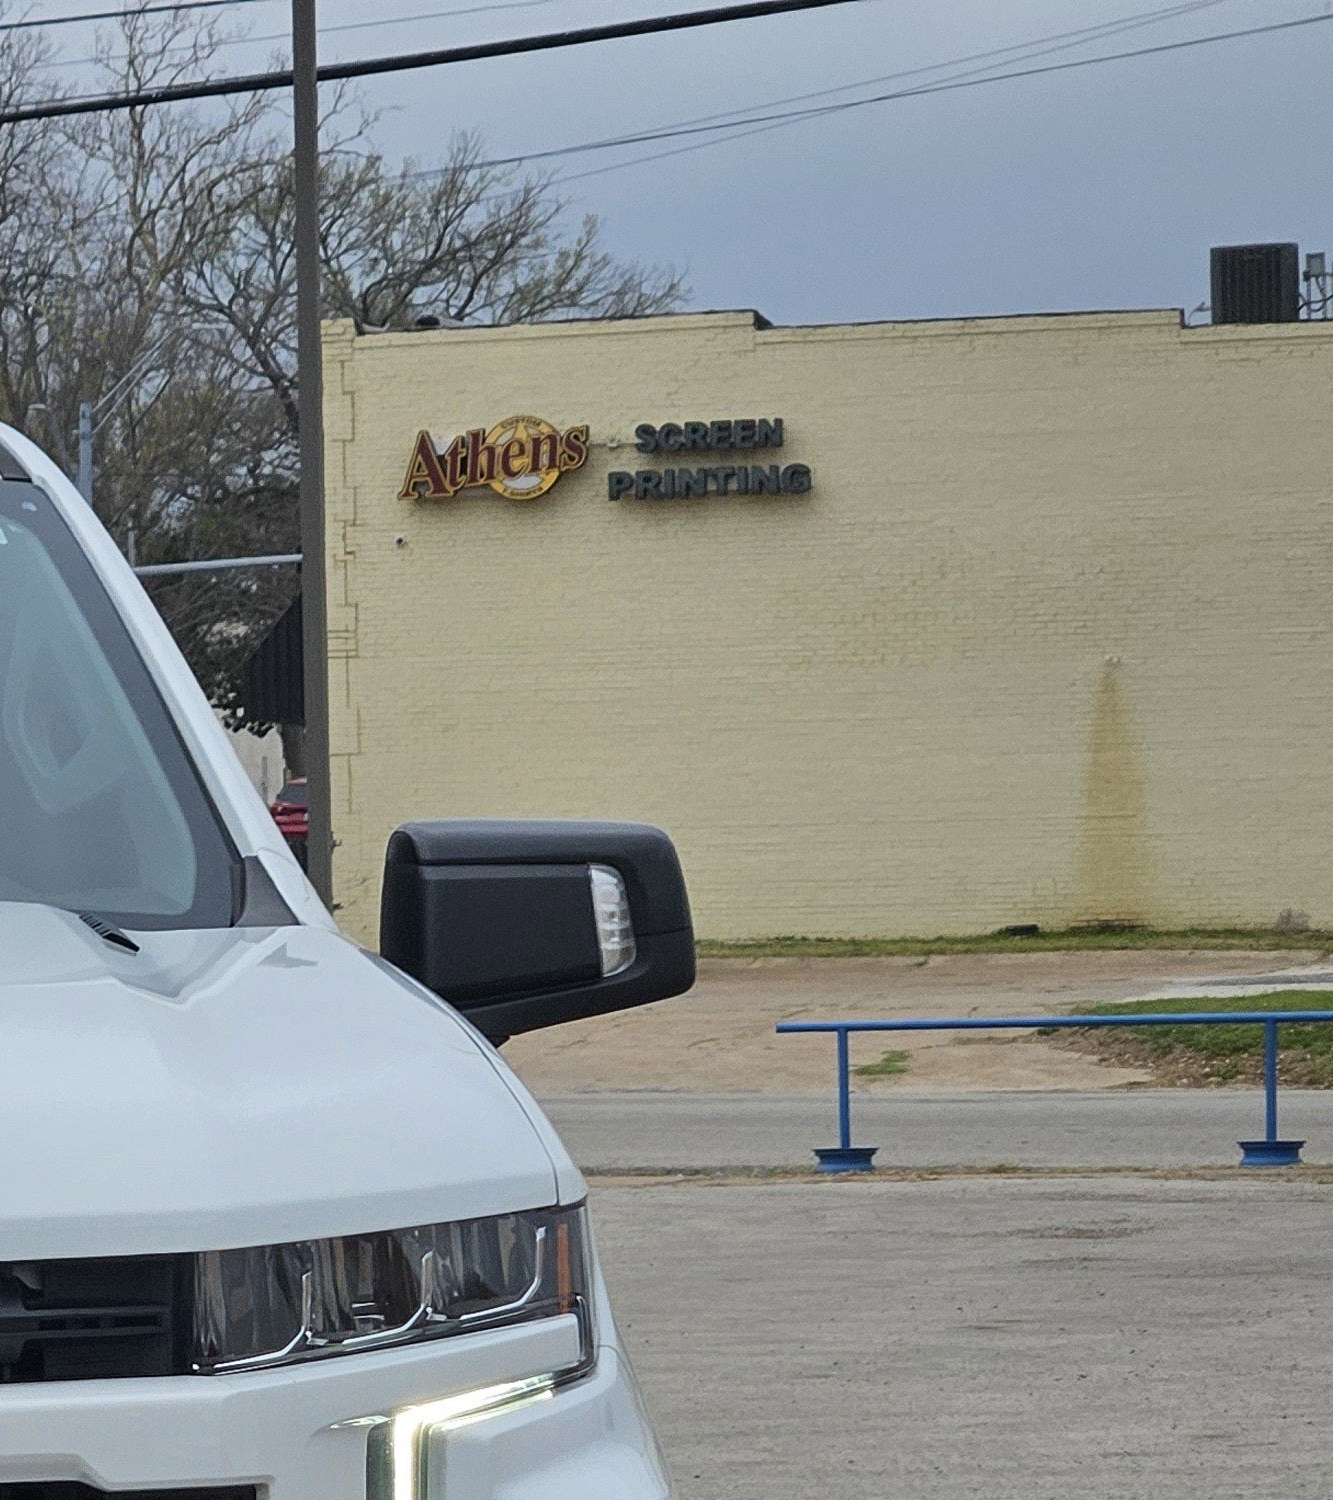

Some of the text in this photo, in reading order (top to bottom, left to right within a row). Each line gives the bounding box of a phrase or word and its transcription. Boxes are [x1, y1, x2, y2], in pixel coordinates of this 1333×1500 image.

[634, 418, 785, 454] SCREEN
[397, 424, 590, 499] Athens
[608, 463, 812, 501] PRINTING
